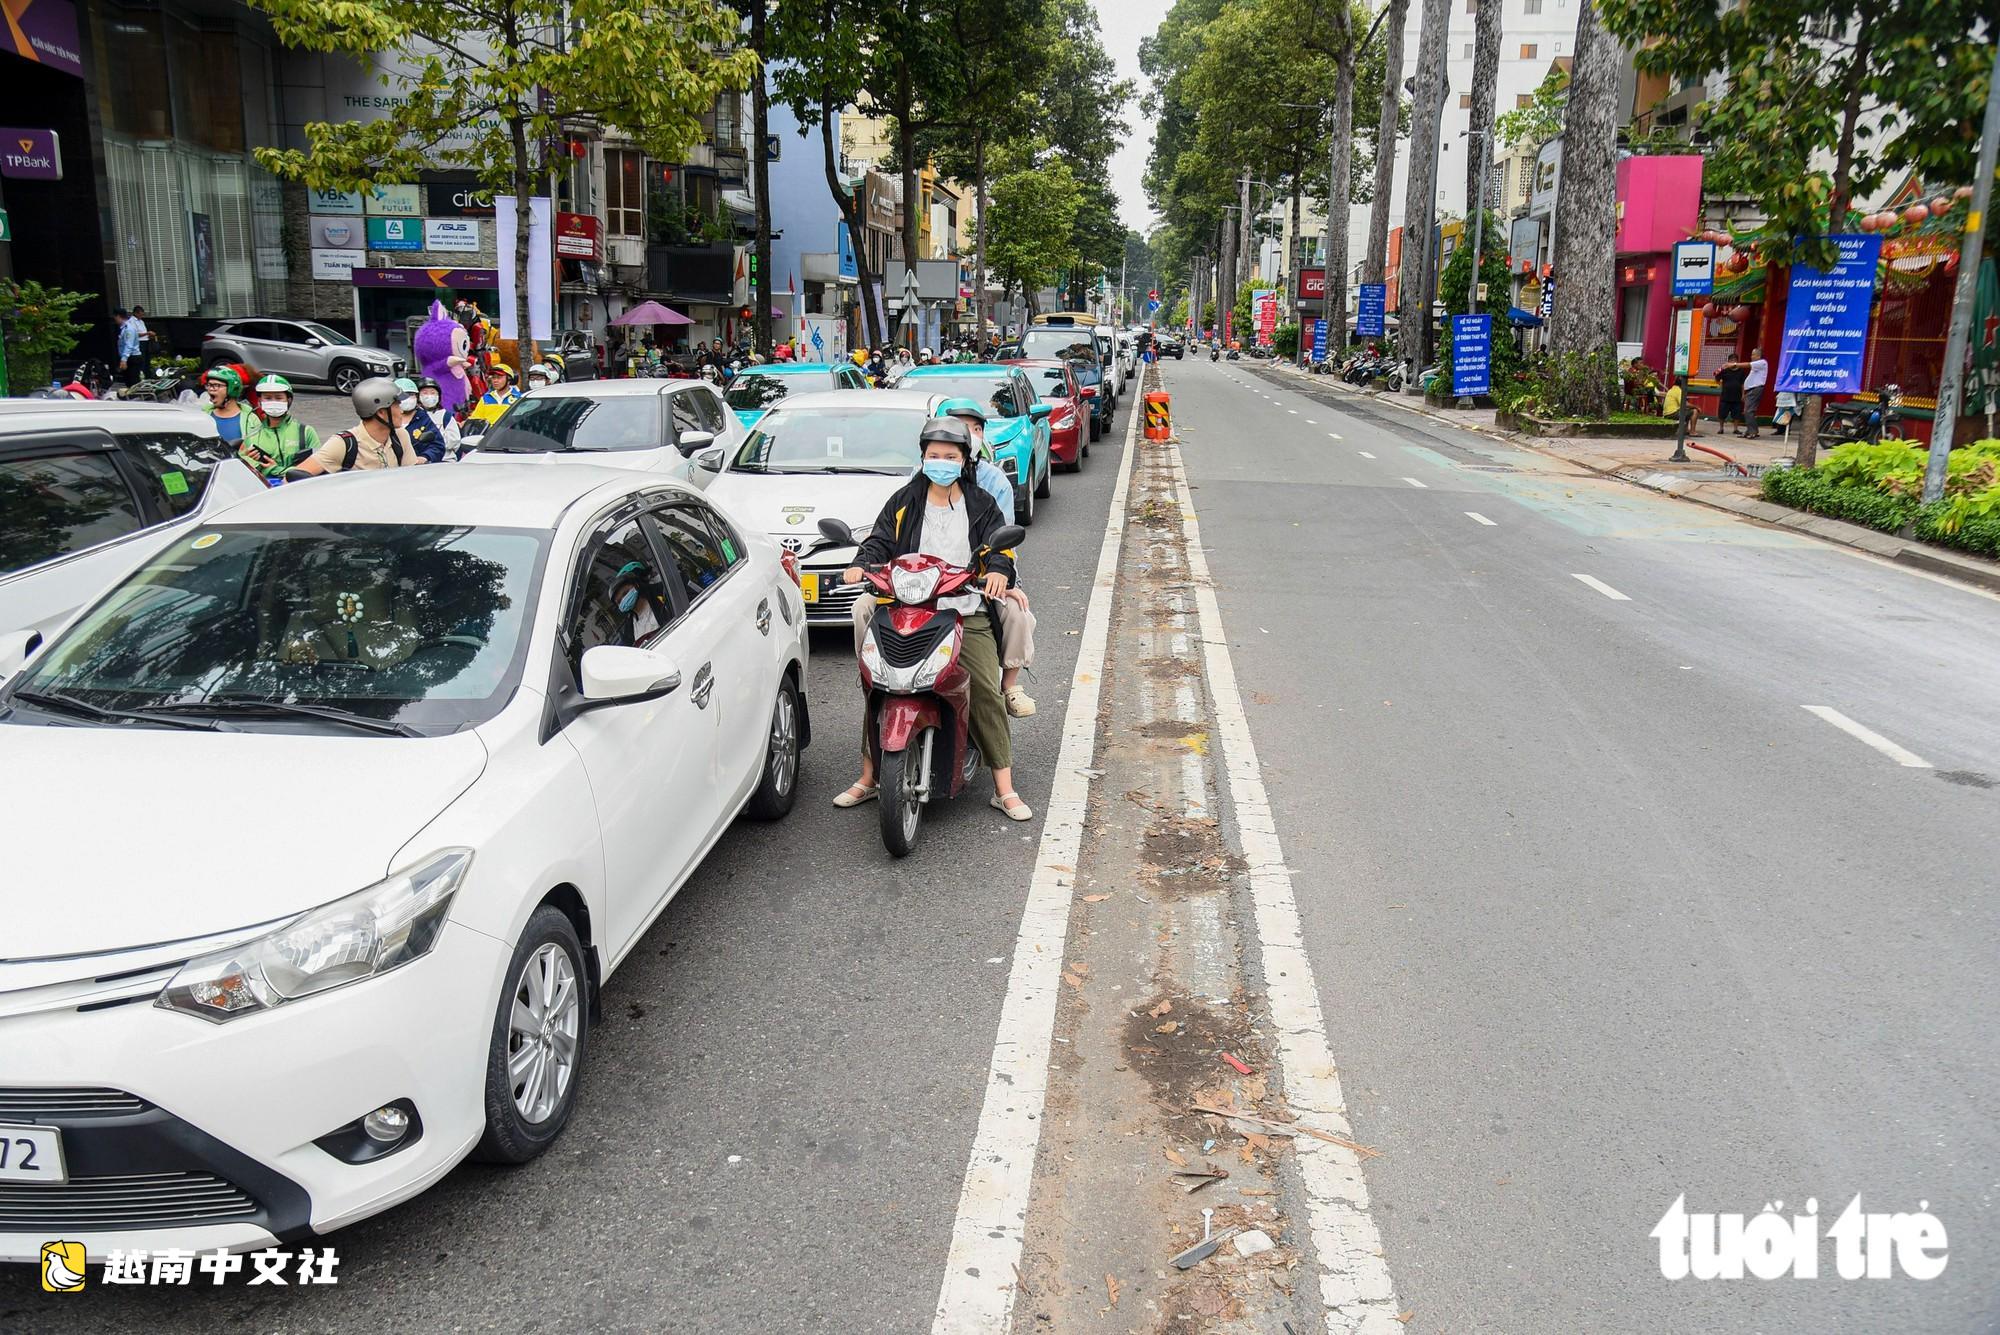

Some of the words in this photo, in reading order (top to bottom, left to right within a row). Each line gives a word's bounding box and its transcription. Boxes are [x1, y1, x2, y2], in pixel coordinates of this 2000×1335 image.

[344, 96, 370, 108] THE
[6, 155, 50, 169] TPBank
[437, 223, 467, 231] ASUS
[1839, 239, 1866, 248] NGÀY
[1792, 278, 1811, 287] CÁCH
[1812, 280, 1832, 289] MẠNG
[1833, 278, 1855, 288] THÁNG
[1856, 278, 1871, 288] TÁM
[1816, 292, 1835, 301] ĐOẠN
[1835, 290, 1844, 300] TỪ
[1810, 302, 1835, 312] NGUYỄN
[1837, 304, 1847, 312] DU
[1819, 315, 1834, 325] ĐẾN
[1788, 327, 1815, 337] NGUYỄN
[1845, 330, 1862, 338] KHAI
[1820, 341, 1838, 349] CÔNG
[1808, 358, 1823, 367] HẠN
[1823, 356, 1838, 366] CHẾ
[1790, 368, 1804, 377] CÁC
[1804, 369, 1832, 378] PHƯƠNG
[1833, 368, 1849, 378] TIỆN
[1799, 380, 1814, 389] LƯU
[1814, 380, 1838, 389] THÔNG
